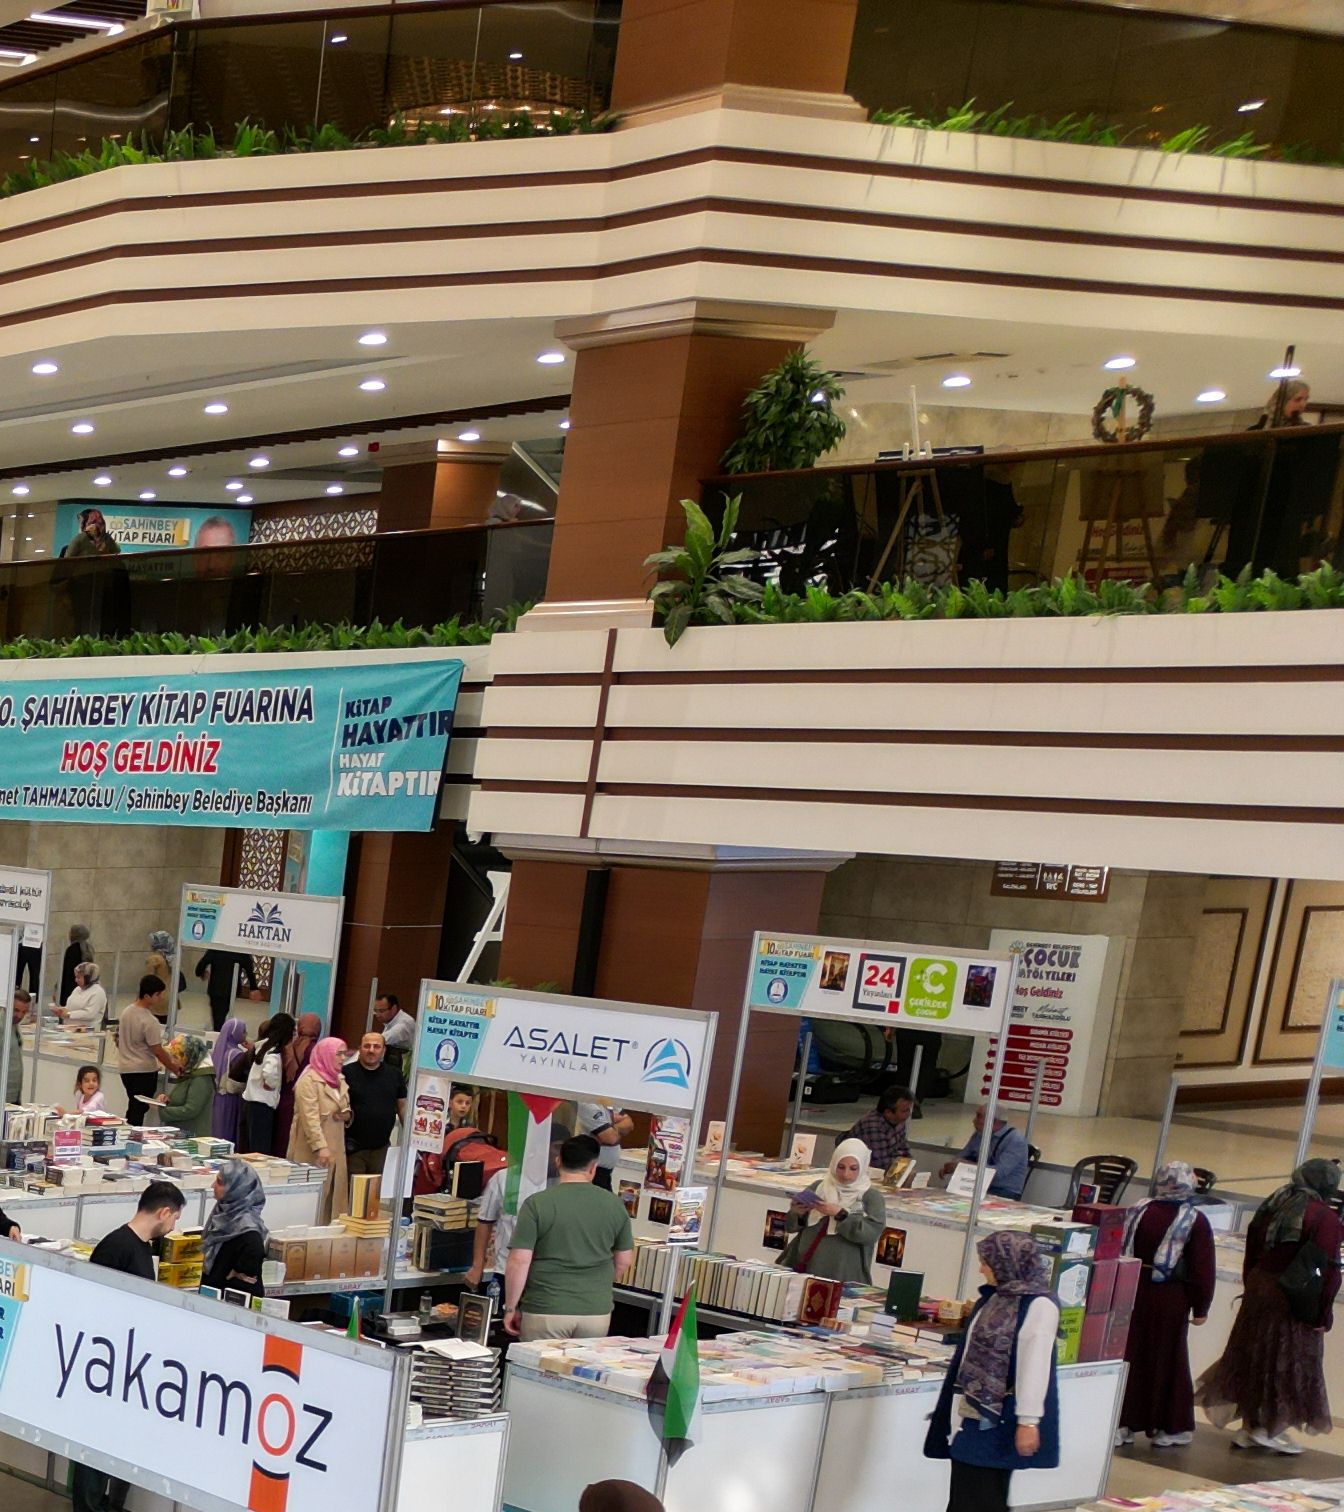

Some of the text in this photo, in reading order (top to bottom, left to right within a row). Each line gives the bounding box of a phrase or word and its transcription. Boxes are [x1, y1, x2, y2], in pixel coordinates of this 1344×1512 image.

[20, 688, 139, 733] ŞAHİNBEY
[138, 685, 207, 726] KİTAP
[209, 686, 314, 724] FUARINA
[345, 696, 392, 719] KİTAP
[342, 710, 455, 748] HAYATTIR
[59, 732, 222, 778] HOŞ GELDİNİZ
[339, 752, 385, 769] HAYAT
[22, 782, 114, 809] TAHMAZOĞLU
[127, 787, 190, 815] Şahinbey
[192, 790, 254, 814] Belediye
[256, 790, 312, 817] Başkanı
[238, 922, 292, 943] HAKTAN
[1024, 949, 1081, 972] ÇOCUK
[864, 965, 895, 988] 24
[503, 1026, 631, 1061] ASALET
[520, 1053, 608, 1075] YAYINLARI
[54, 1323, 334, 1473] yakamoz
